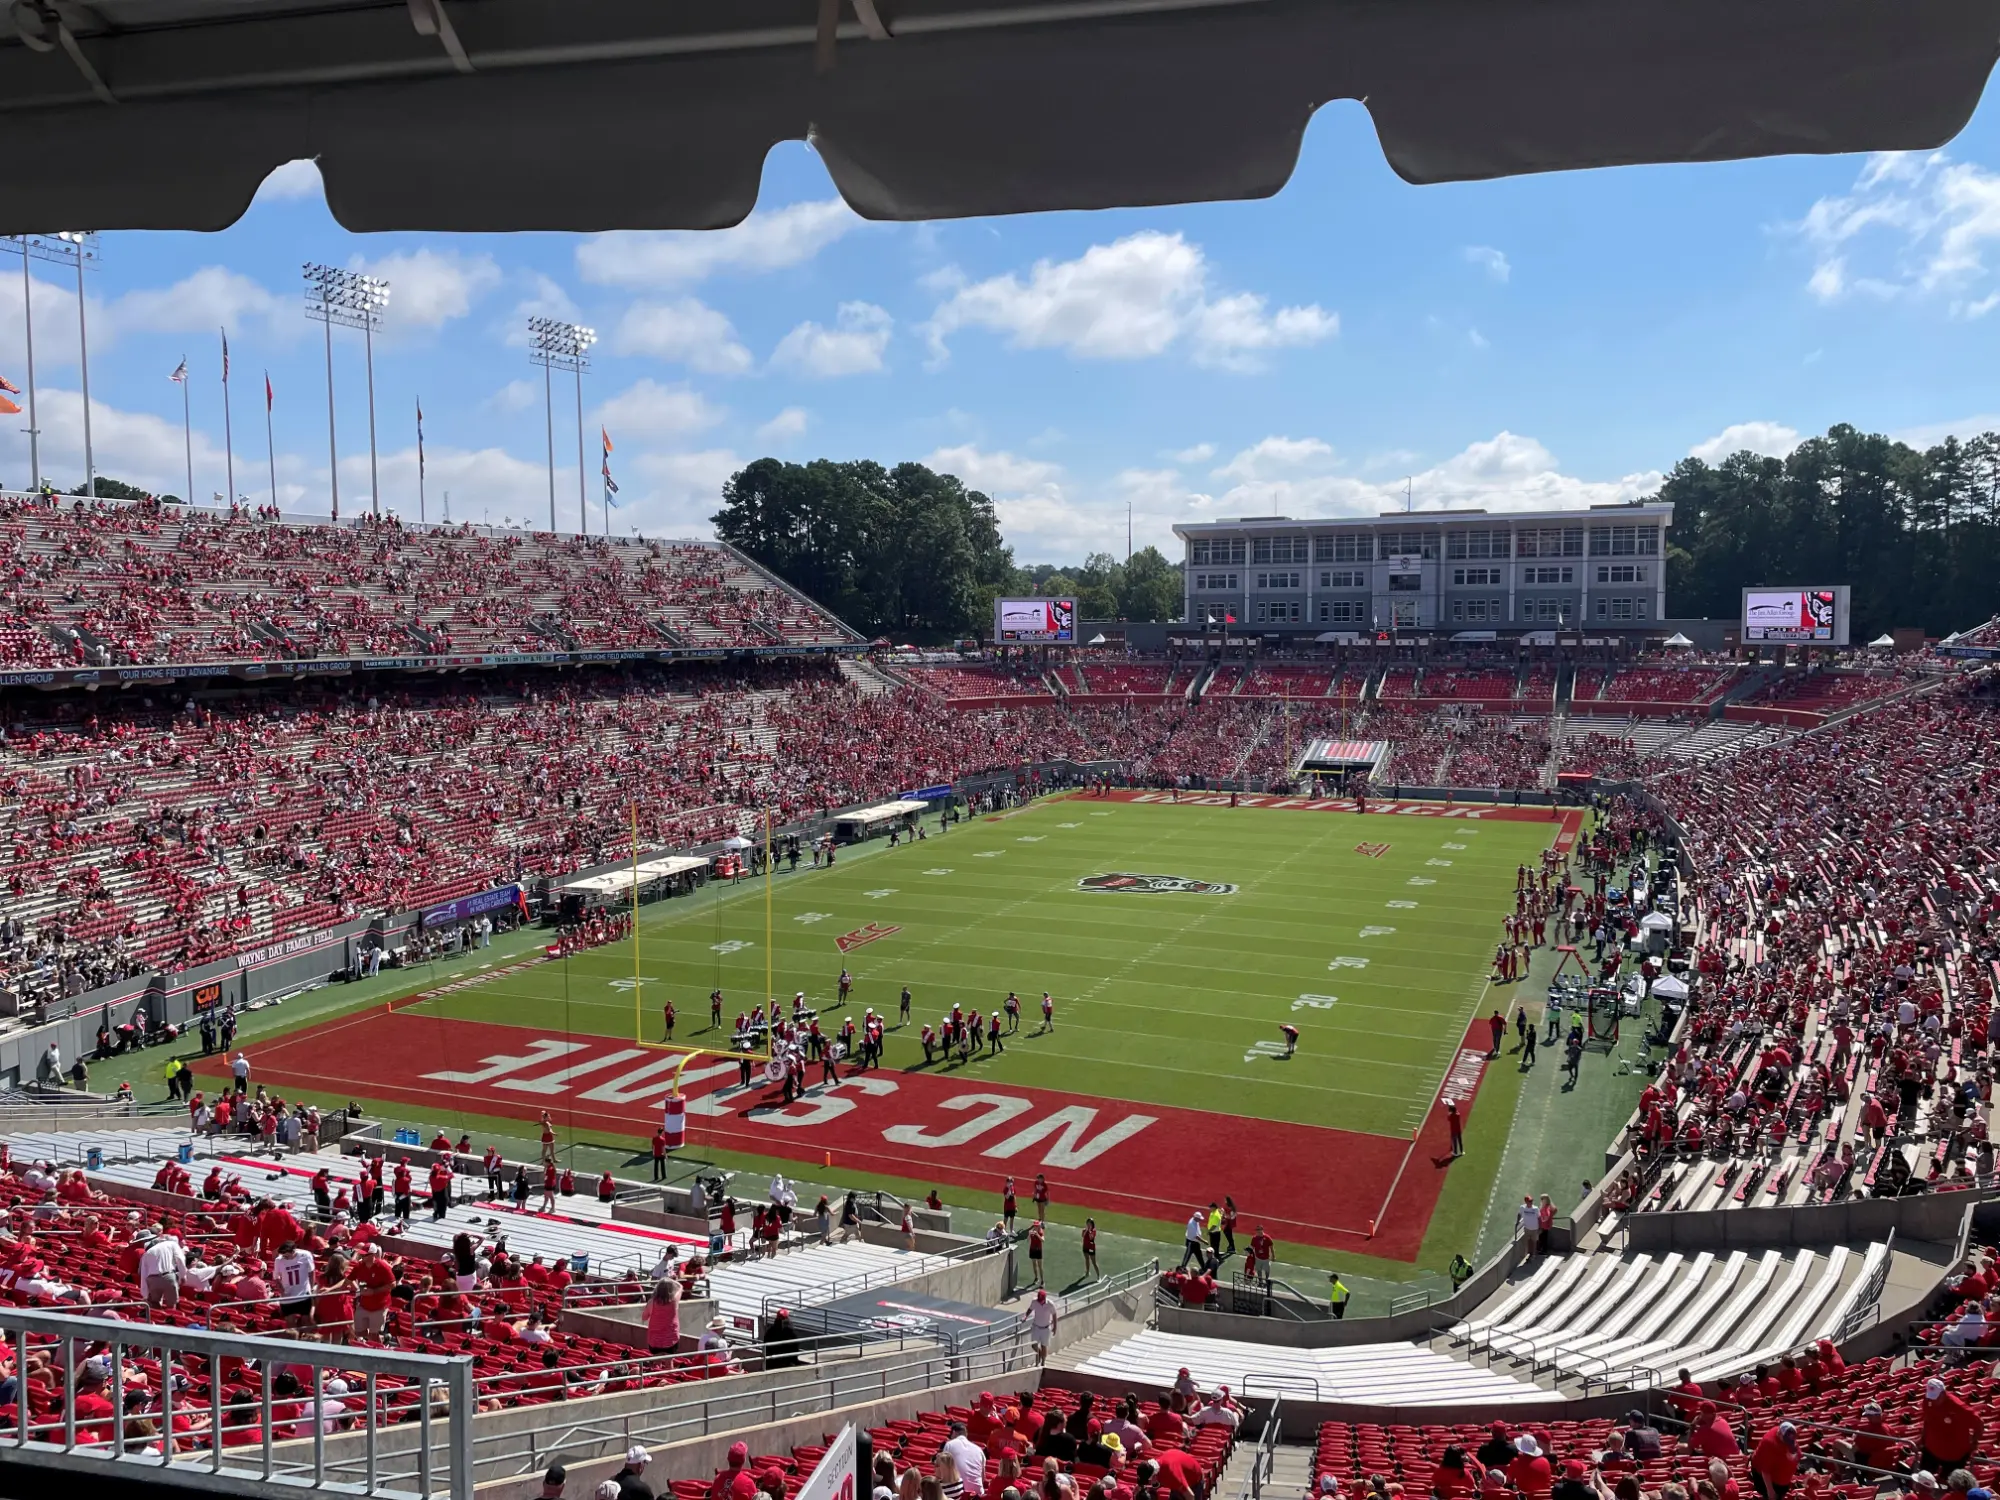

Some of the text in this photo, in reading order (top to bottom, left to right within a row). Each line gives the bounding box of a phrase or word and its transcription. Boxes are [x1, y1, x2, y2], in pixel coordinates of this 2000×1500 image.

[620, 652, 645, 660] ADVANTAGE
[118, 666, 230, 679] YOUR HOME FIELD ADVANTAGE
[282, 664, 294, 673] THE
[307, 663, 329, 672] ALLEN
[329, 662, 351, 671] GROUP
[0, 673, 54, 685] LLEN GROUP
[472, 897, 483, 906] REAL
[483, 892, 499, 902] ESTATE
[499, 889, 511, 898] TEAM
[475, 902, 490, 912] NORTH
[490, 896, 511, 908] CAROLINA
[834, 921, 903, 954] ACC
[237, 929, 334, 969] WAYNE DAY FAMILY FIELD
[173, 977, 179, 986] 1
[1294, 993, 1338, 1010] 20
[417, 1038, 1160, 1170] NC STATE
[0, 1268, 15, 1287] 7
[287, 1269, 300, 1286] 11
[827, 1442, 853, 1490] SECTION
